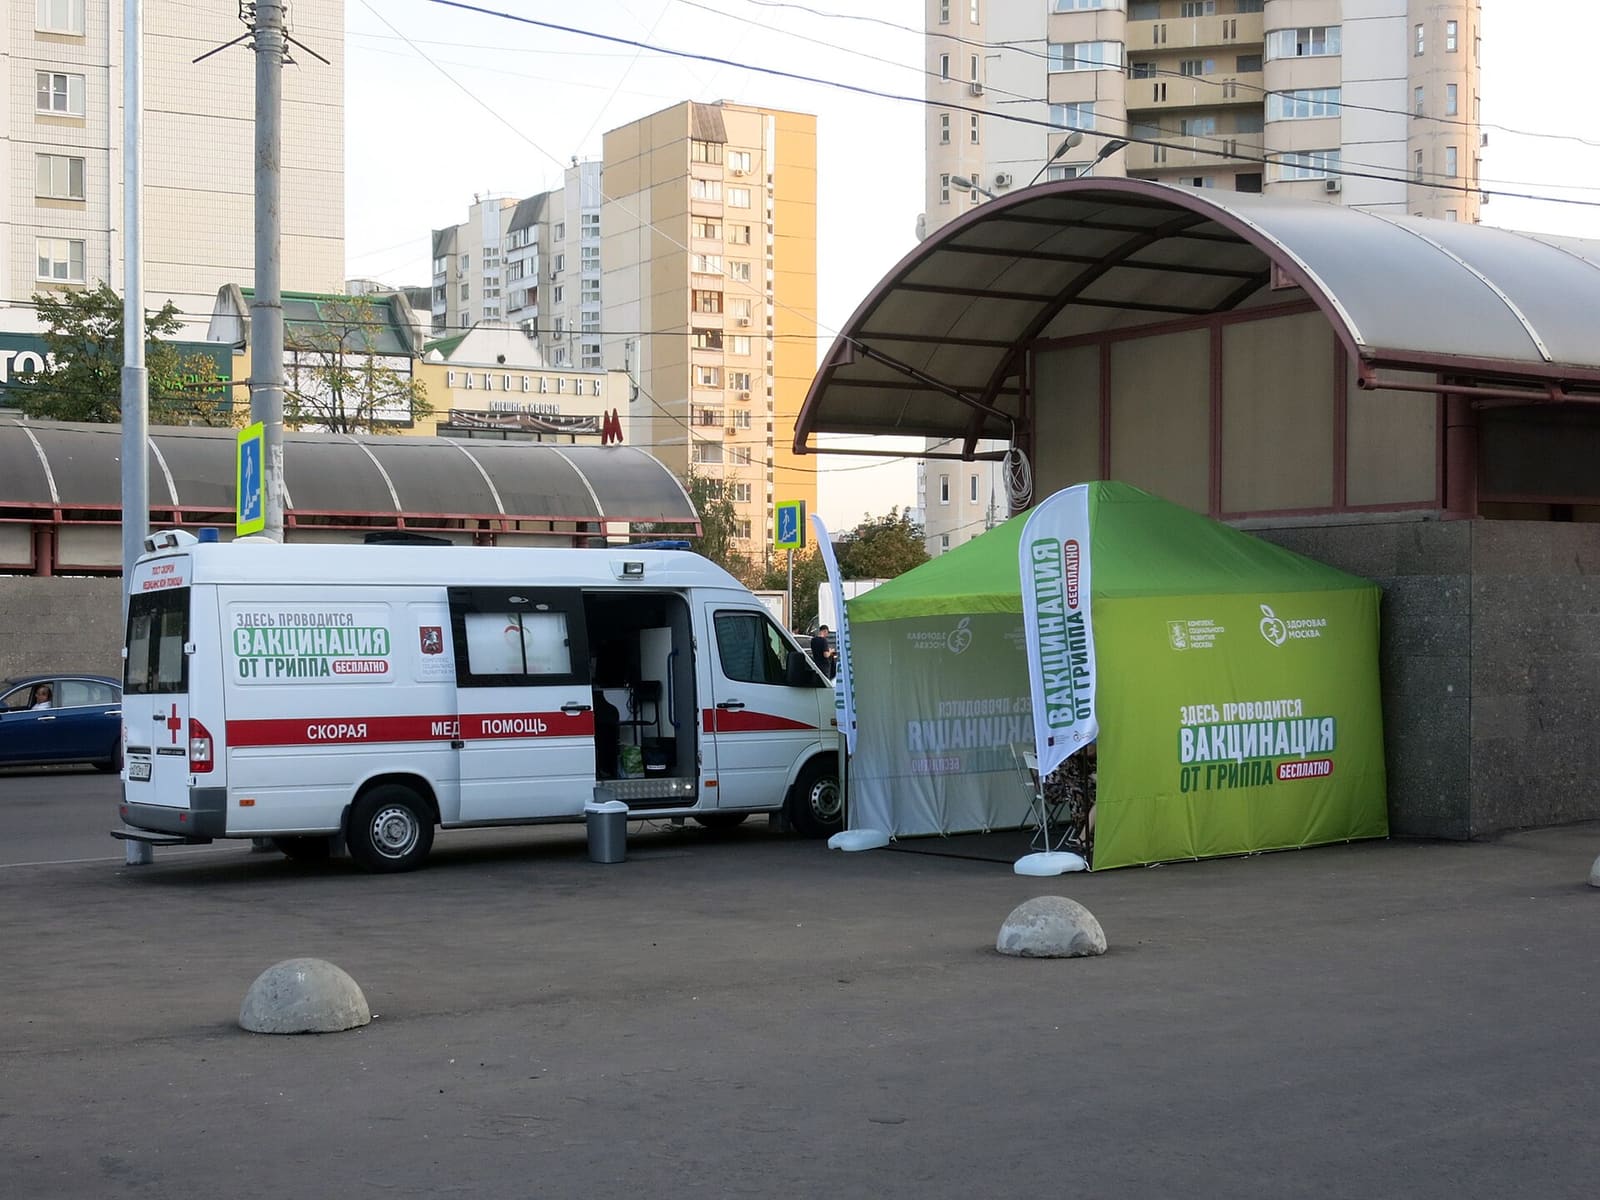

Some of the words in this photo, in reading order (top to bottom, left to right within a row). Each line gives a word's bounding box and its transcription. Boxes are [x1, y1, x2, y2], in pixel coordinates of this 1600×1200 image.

[448, 371, 601, 396] РАКОВАРНЯ
[1065, 544, 1078, 605] БЕСПЛАТНО
[236, 613, 275, 627] ЗДЕСЬ
[279, 613, 353, 627] ПРОВОДИТСЯ
[1286, 618, 1327, 629] ЗДОРОВАЯ
[237, 628, 388, 657] ВАКЦИНАЦИЯ
[1032, 543, 1073, 725] ВАКЦИНАЦИЯ
[1288, 630, 1321, 639] МОСКВА
[1067, 611, 1090, 690] ГРИППА
[239, 658, 261, 678] ОТ
[265, 657, 330, 678] ГРИППА
[335, 661, 385, 673] БЕСПЛАТНО
[1075, 698, 1091, 720] ОТ
[1180, 704, 1219, 726] ЗДЕСЬ
[1223, 699, 1302, 722] ПРОВОДИТСЯ
[306, 723, 367, 740] СКОРАЯ
[481, 718, 547, 736] ПОМОЩЬ
[1181, 717, 1334, 763] ВАКЦИНАЦИЯ
[1180, 765, 1200, 793] ОТ
[1206, 760, 1274, 790] ГРИППА
[1279, 761, 1330, 779] БЕСПЛАТНО
